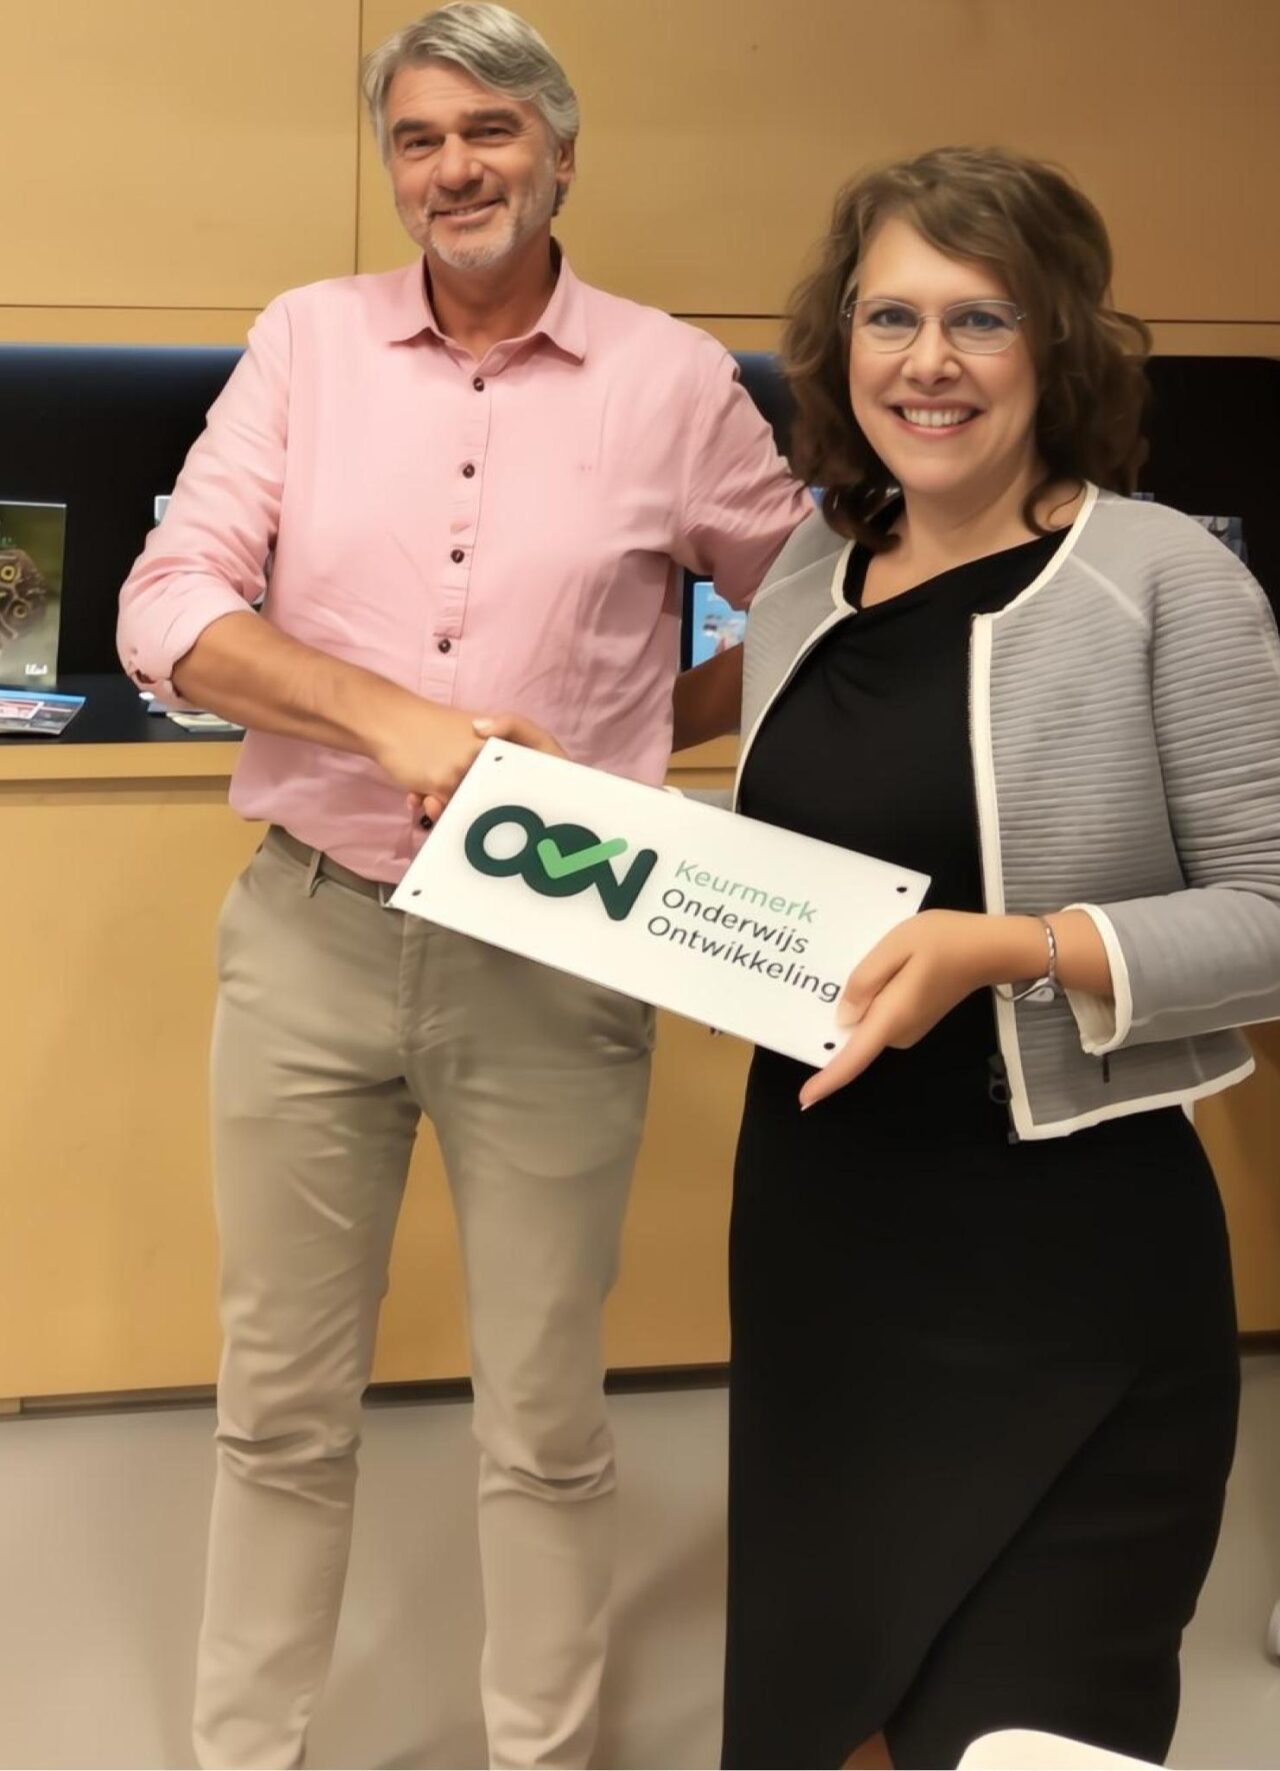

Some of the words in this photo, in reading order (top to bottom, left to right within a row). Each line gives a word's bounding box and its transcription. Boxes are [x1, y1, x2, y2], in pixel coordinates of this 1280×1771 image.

[662, 888, 809, 955] Onderwijs
[675, 860, 819, 924] Keurmerk
[647, 915, 842, 1004] Ontwikkeling
